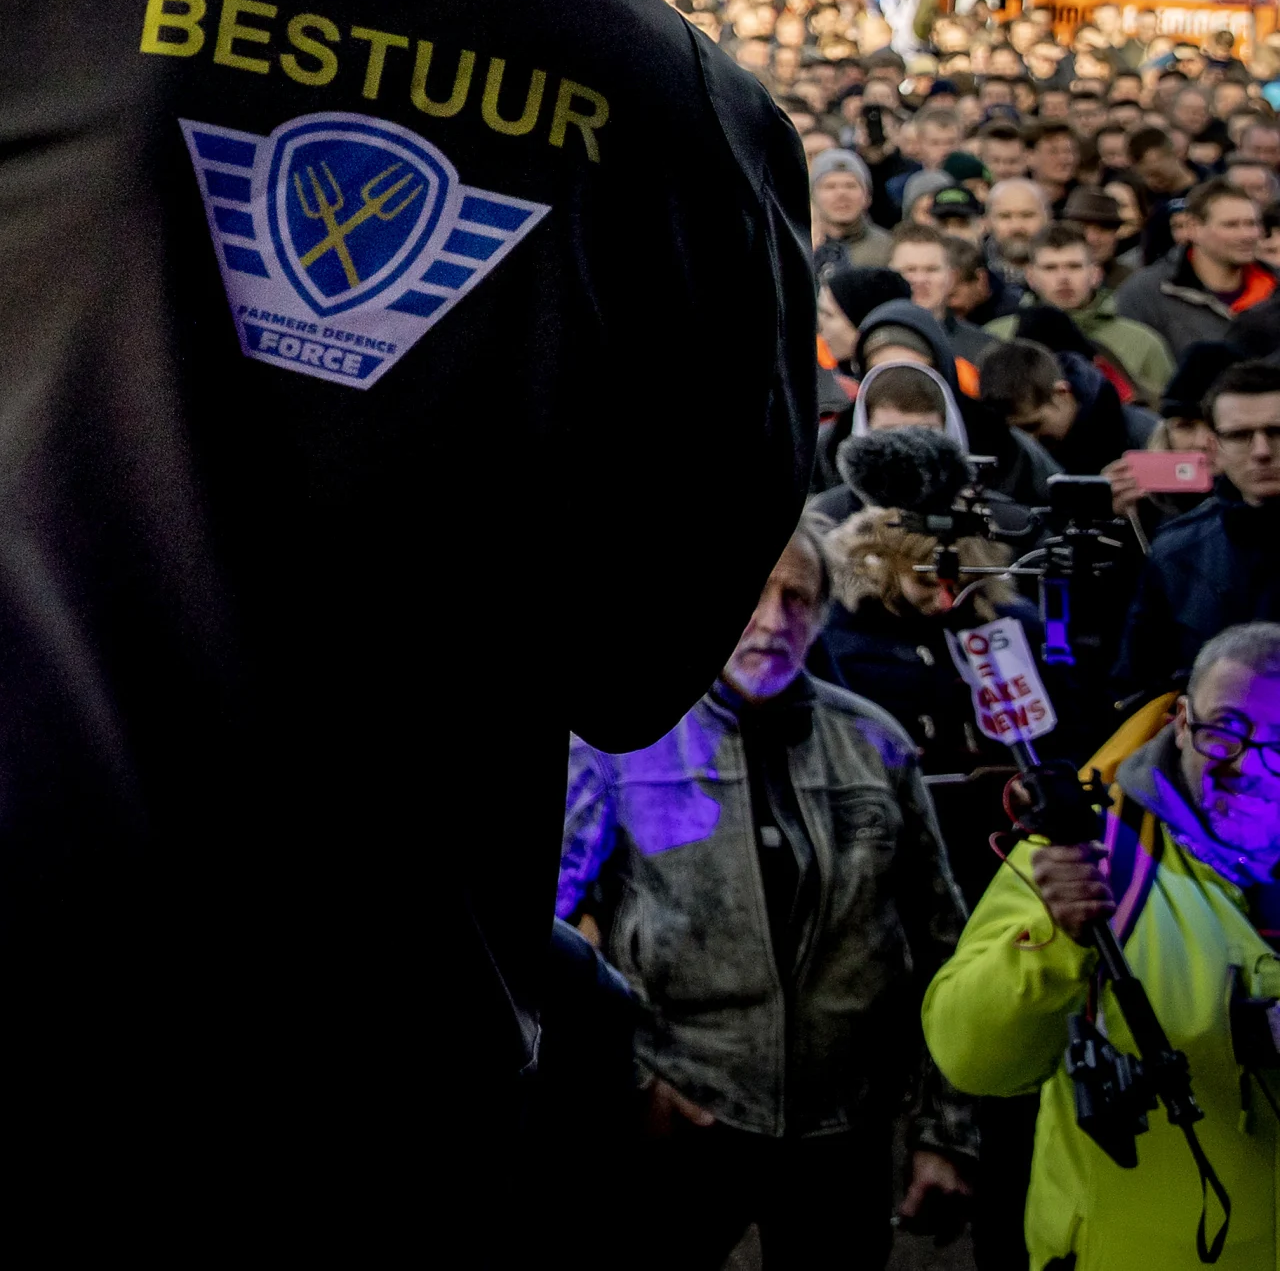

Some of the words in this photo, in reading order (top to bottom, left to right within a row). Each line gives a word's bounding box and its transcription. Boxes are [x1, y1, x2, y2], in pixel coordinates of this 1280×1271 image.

[237, 305, 319, 335] FARMERS
[322, 327, 397, 355] DEFENCE
[258, 331, 363, 376] FORCE
[967, 630, 1010, 656] OS
[977, 674, 1032, 710] AKE
